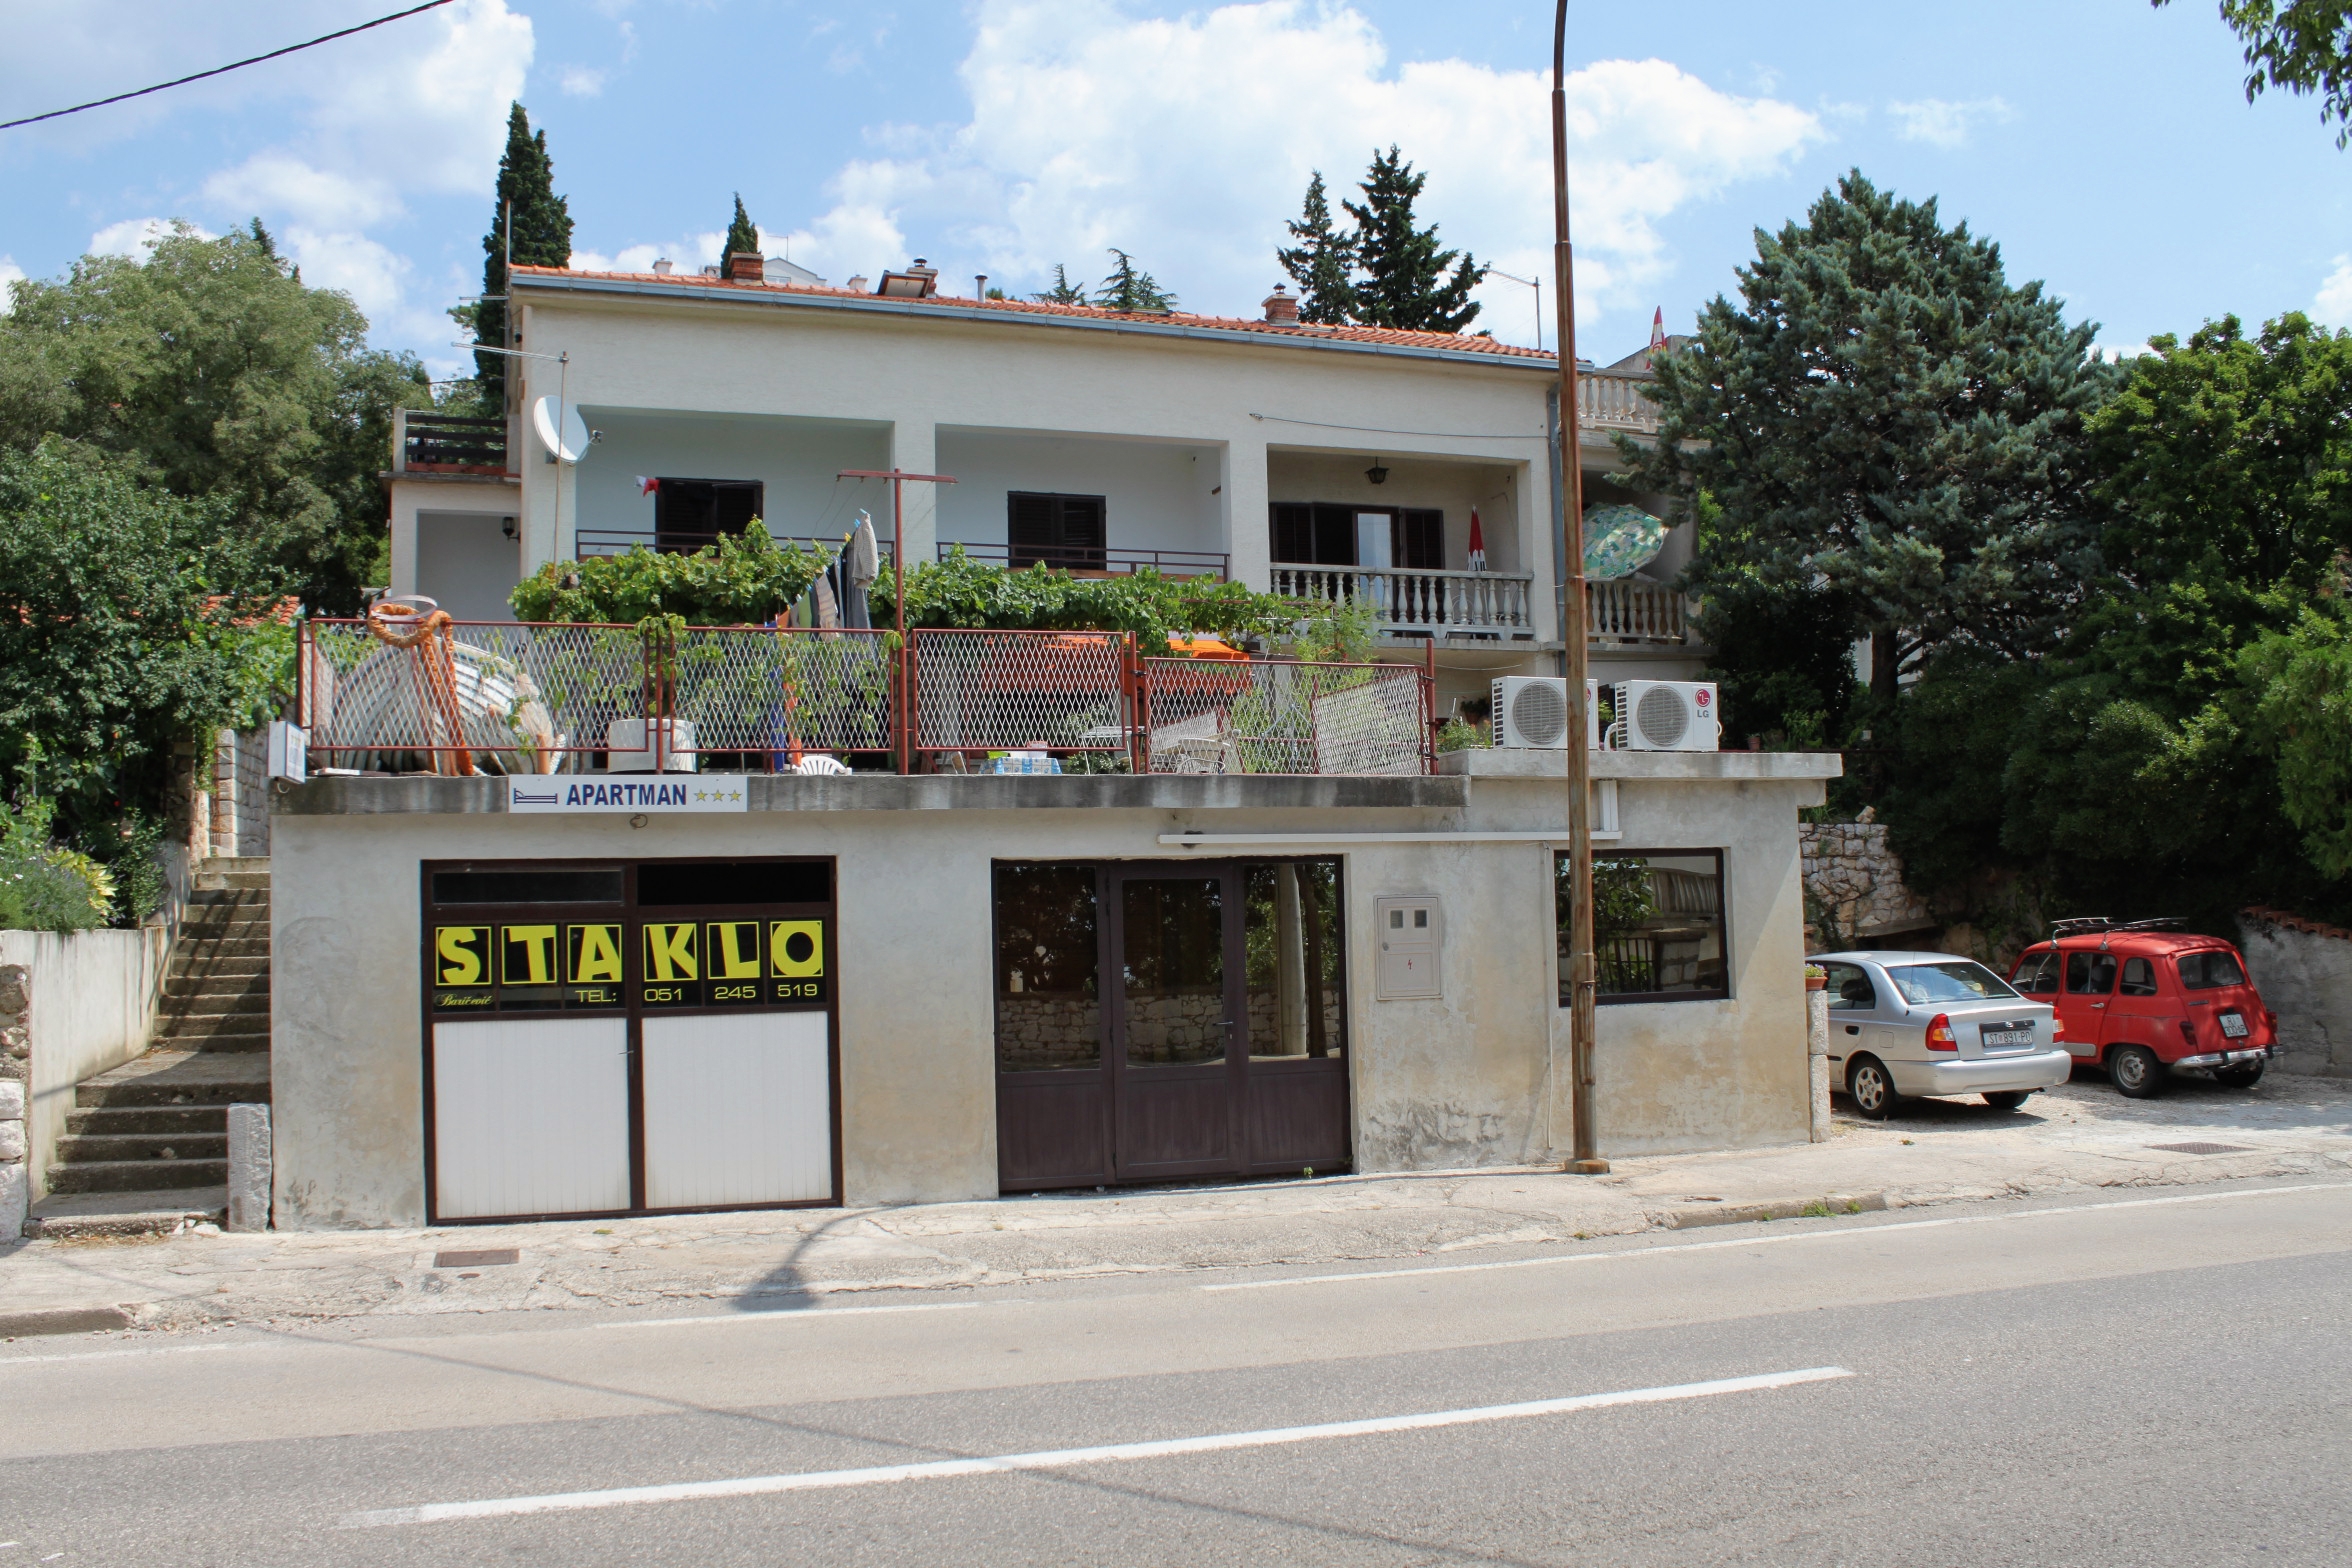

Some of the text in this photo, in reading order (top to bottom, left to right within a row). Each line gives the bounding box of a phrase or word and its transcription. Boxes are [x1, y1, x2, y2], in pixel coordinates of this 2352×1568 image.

[566, 784, 687, 806] APARTMAN
[435, 920, 824, 986] STAKLO
[575, 983, 818, 1003] TEL: 051 245 519
[1989, 1033, 1999, 1044] ST
